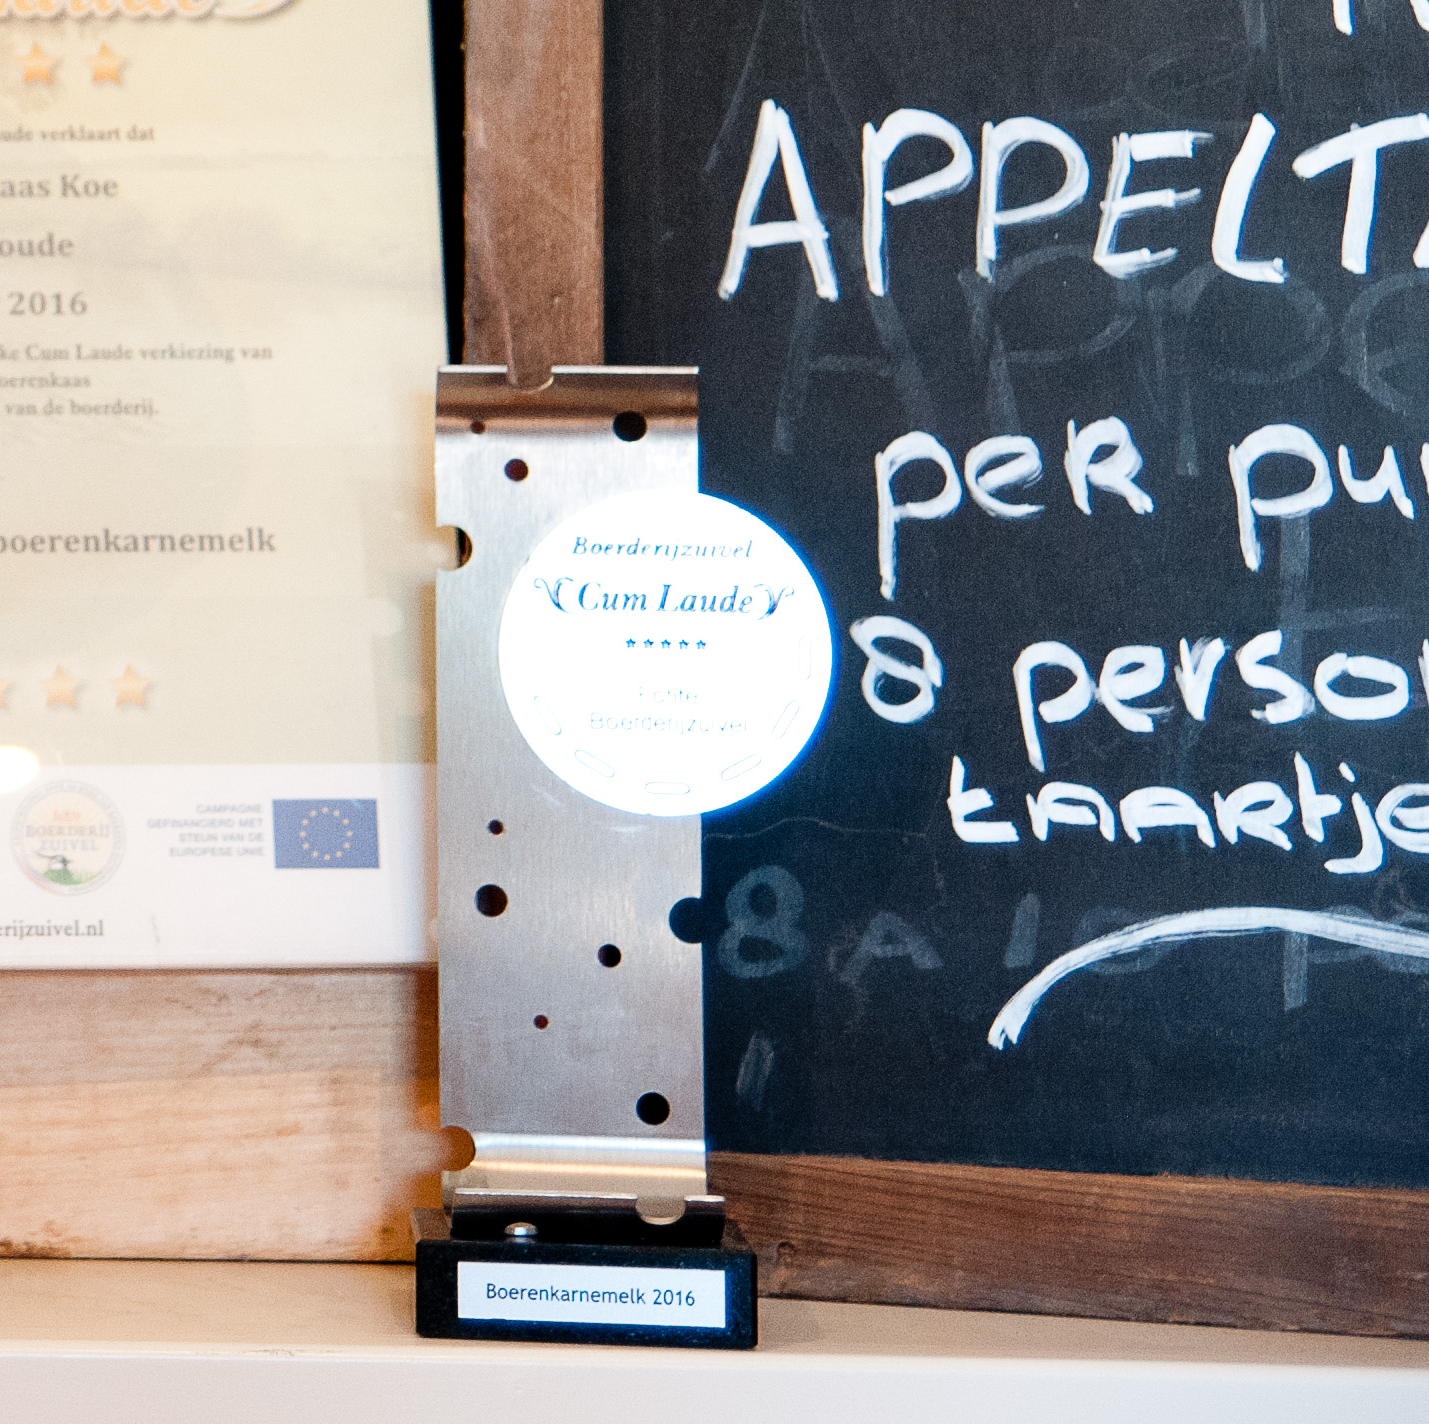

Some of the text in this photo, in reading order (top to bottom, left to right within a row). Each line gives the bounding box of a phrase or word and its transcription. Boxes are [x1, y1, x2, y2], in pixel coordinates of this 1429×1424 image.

[41, 125, 121, 142] verklaart
[127, 125, 155, 142] dat
[60, 173, 120, 199] Koe
[719, 99, 1429, 301] APPELT
[7, 290, 89, 317] 2016
[25, 343, 70, 361] Cum
[75, 342, 133, 361] Laude
[139, 343, 235, 363] verkiezing
[240, 346, 273, 361] van
[5, 403, 38, 416] van
[43, 398, 65, 416] de
[1229, 424, 1429, 573] pu
[578, 581, 755, 614] Cum Laude
[1014, 629, 1429, 772] perso
[486, 1282, 696, 1307] Boerenkarnemelk 2016
